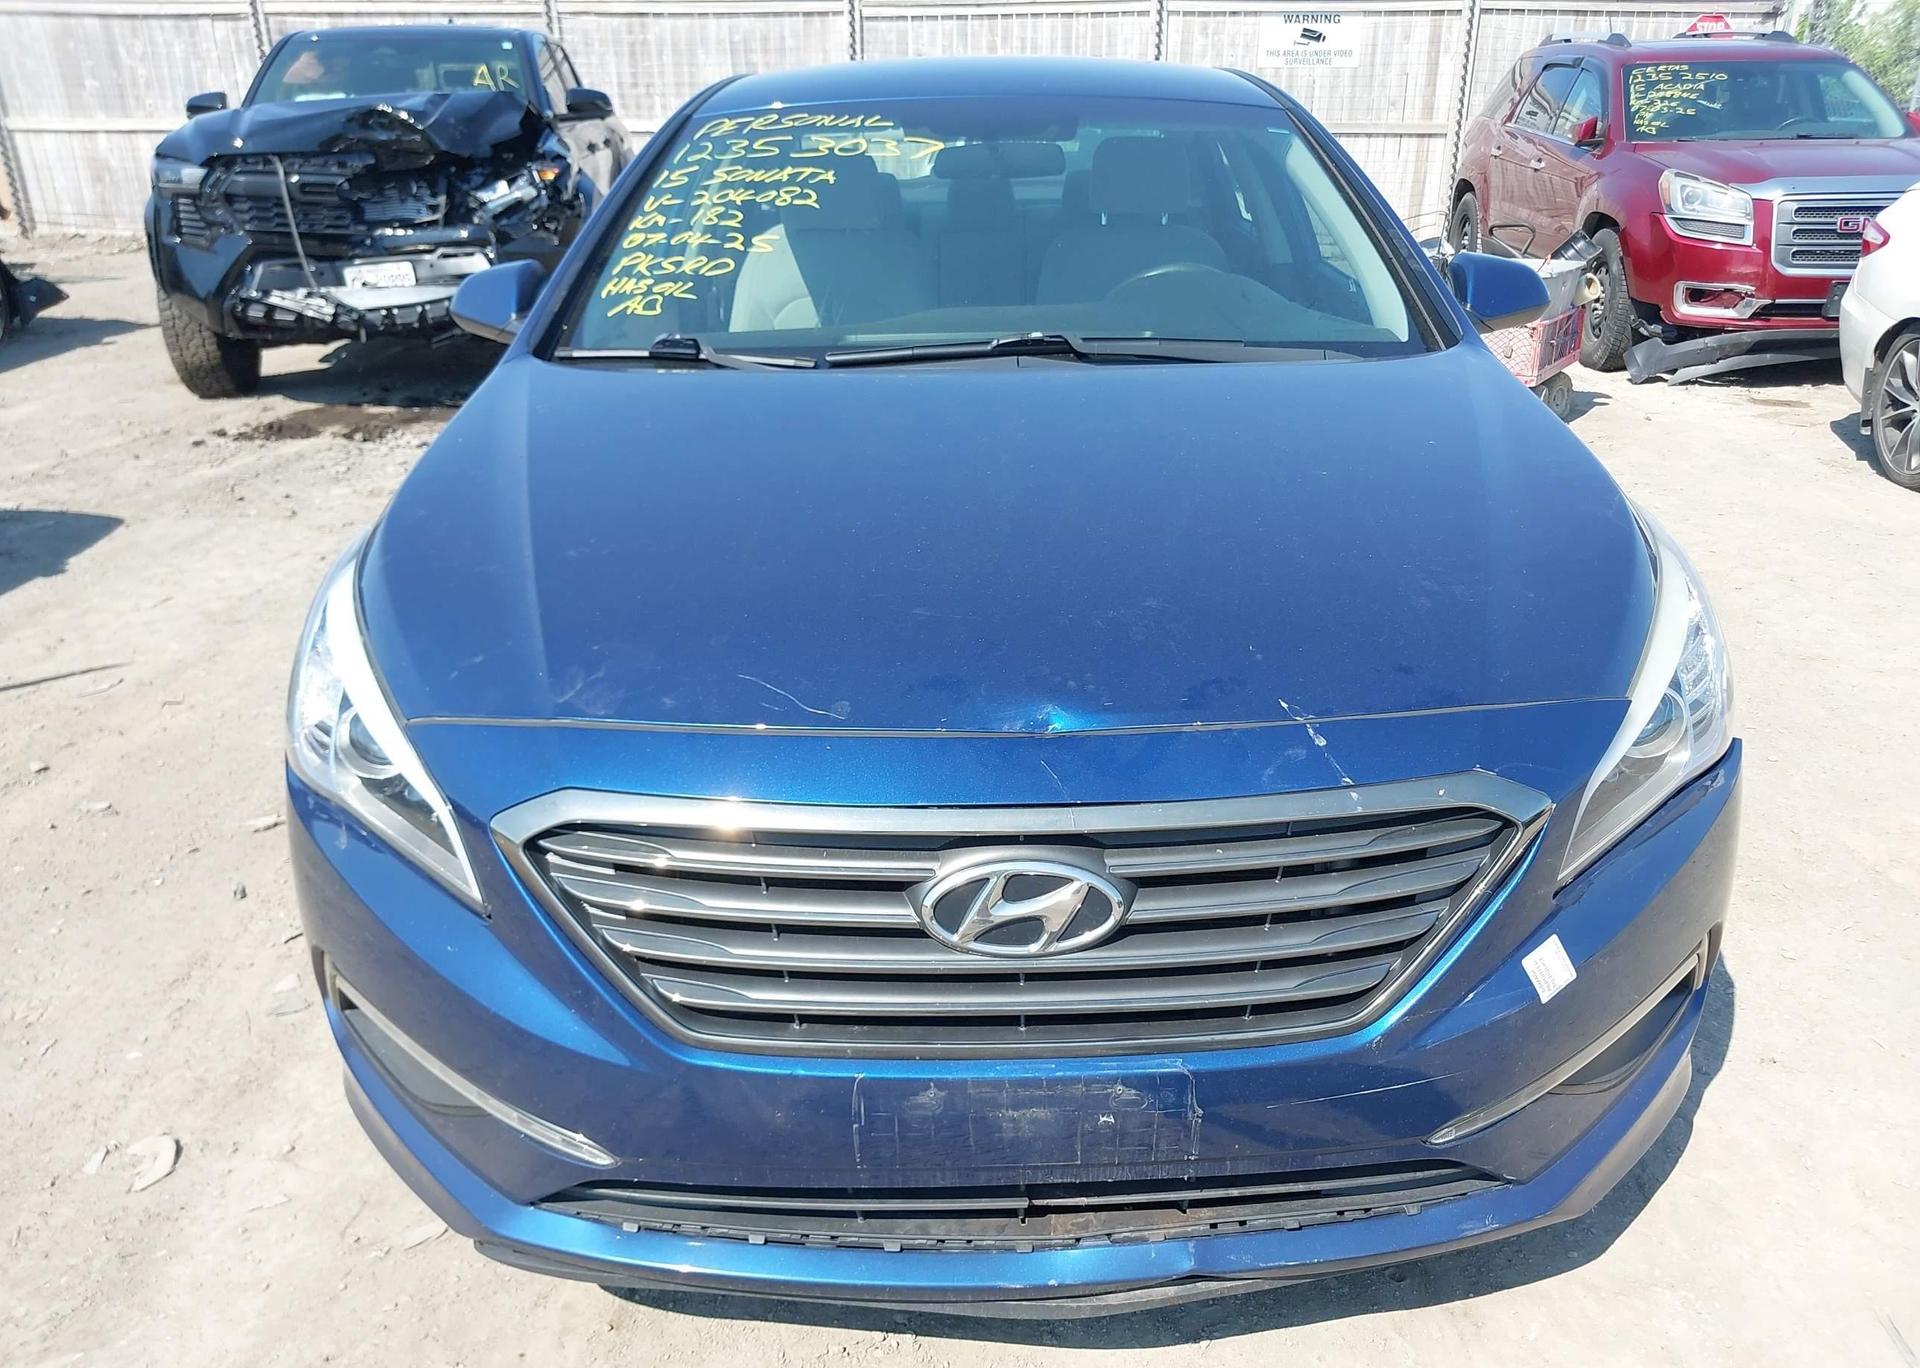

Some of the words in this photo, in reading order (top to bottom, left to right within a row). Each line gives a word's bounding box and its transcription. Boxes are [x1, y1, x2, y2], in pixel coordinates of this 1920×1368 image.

[1283, 14, 1341, 24] WARNING
[1266, 49, 1281, 57] THIS
[1282, 49, 1299, 57] AREA
[1300, 49, 1307, 57] IS
[1309, 49, 1332, 57] UNDER
[1333, 49, 1353, 57] VIDEO
[1284, 58, 1332, 66] SURVEILLANCE
[473, 63, 520, 91] AR
[693, 113, 894, 141] PERSONAL
[673, 135, 793, 165] 1235
[789, 135, 945, 160] 3037
[652, 165, 700, 189] 15
[701, 165, 837, 186] SONATA
[690, 186, 821, 208] 204082
